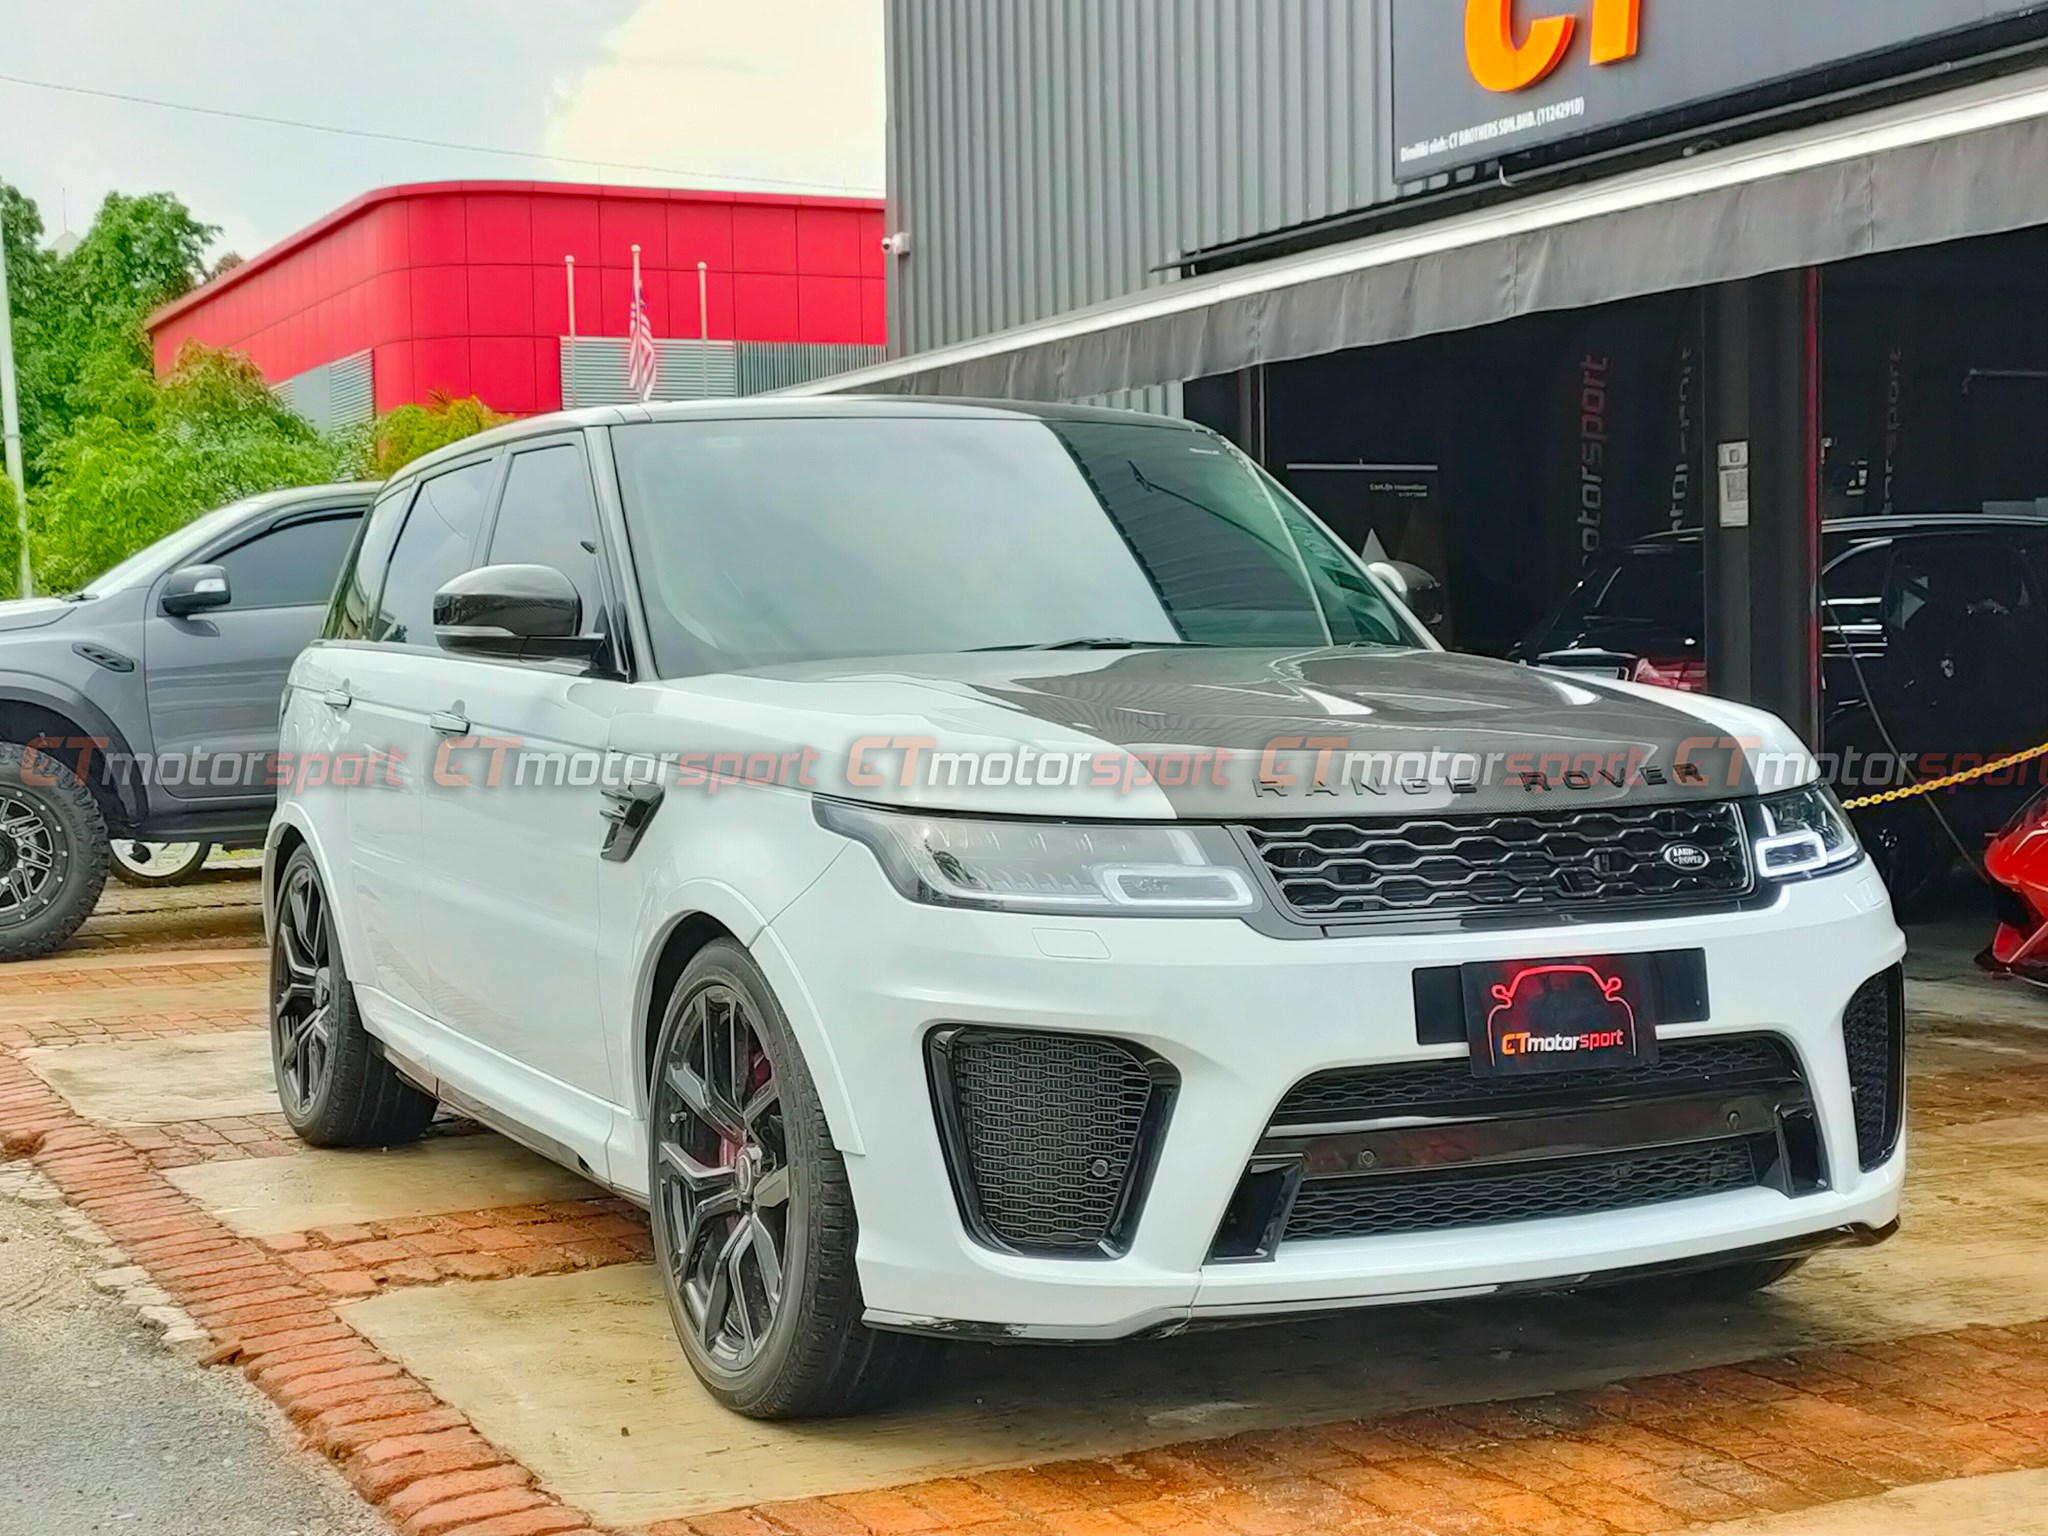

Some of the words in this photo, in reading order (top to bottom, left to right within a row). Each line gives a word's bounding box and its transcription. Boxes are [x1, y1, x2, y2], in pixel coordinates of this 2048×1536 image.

[1449, 132, 1459, 149] CT
[1459, 118, 1499, 147] BROTHERS
[1253, 775, 1478, 798] RANGE
[1519, 763, 1704, 792] ROVER
